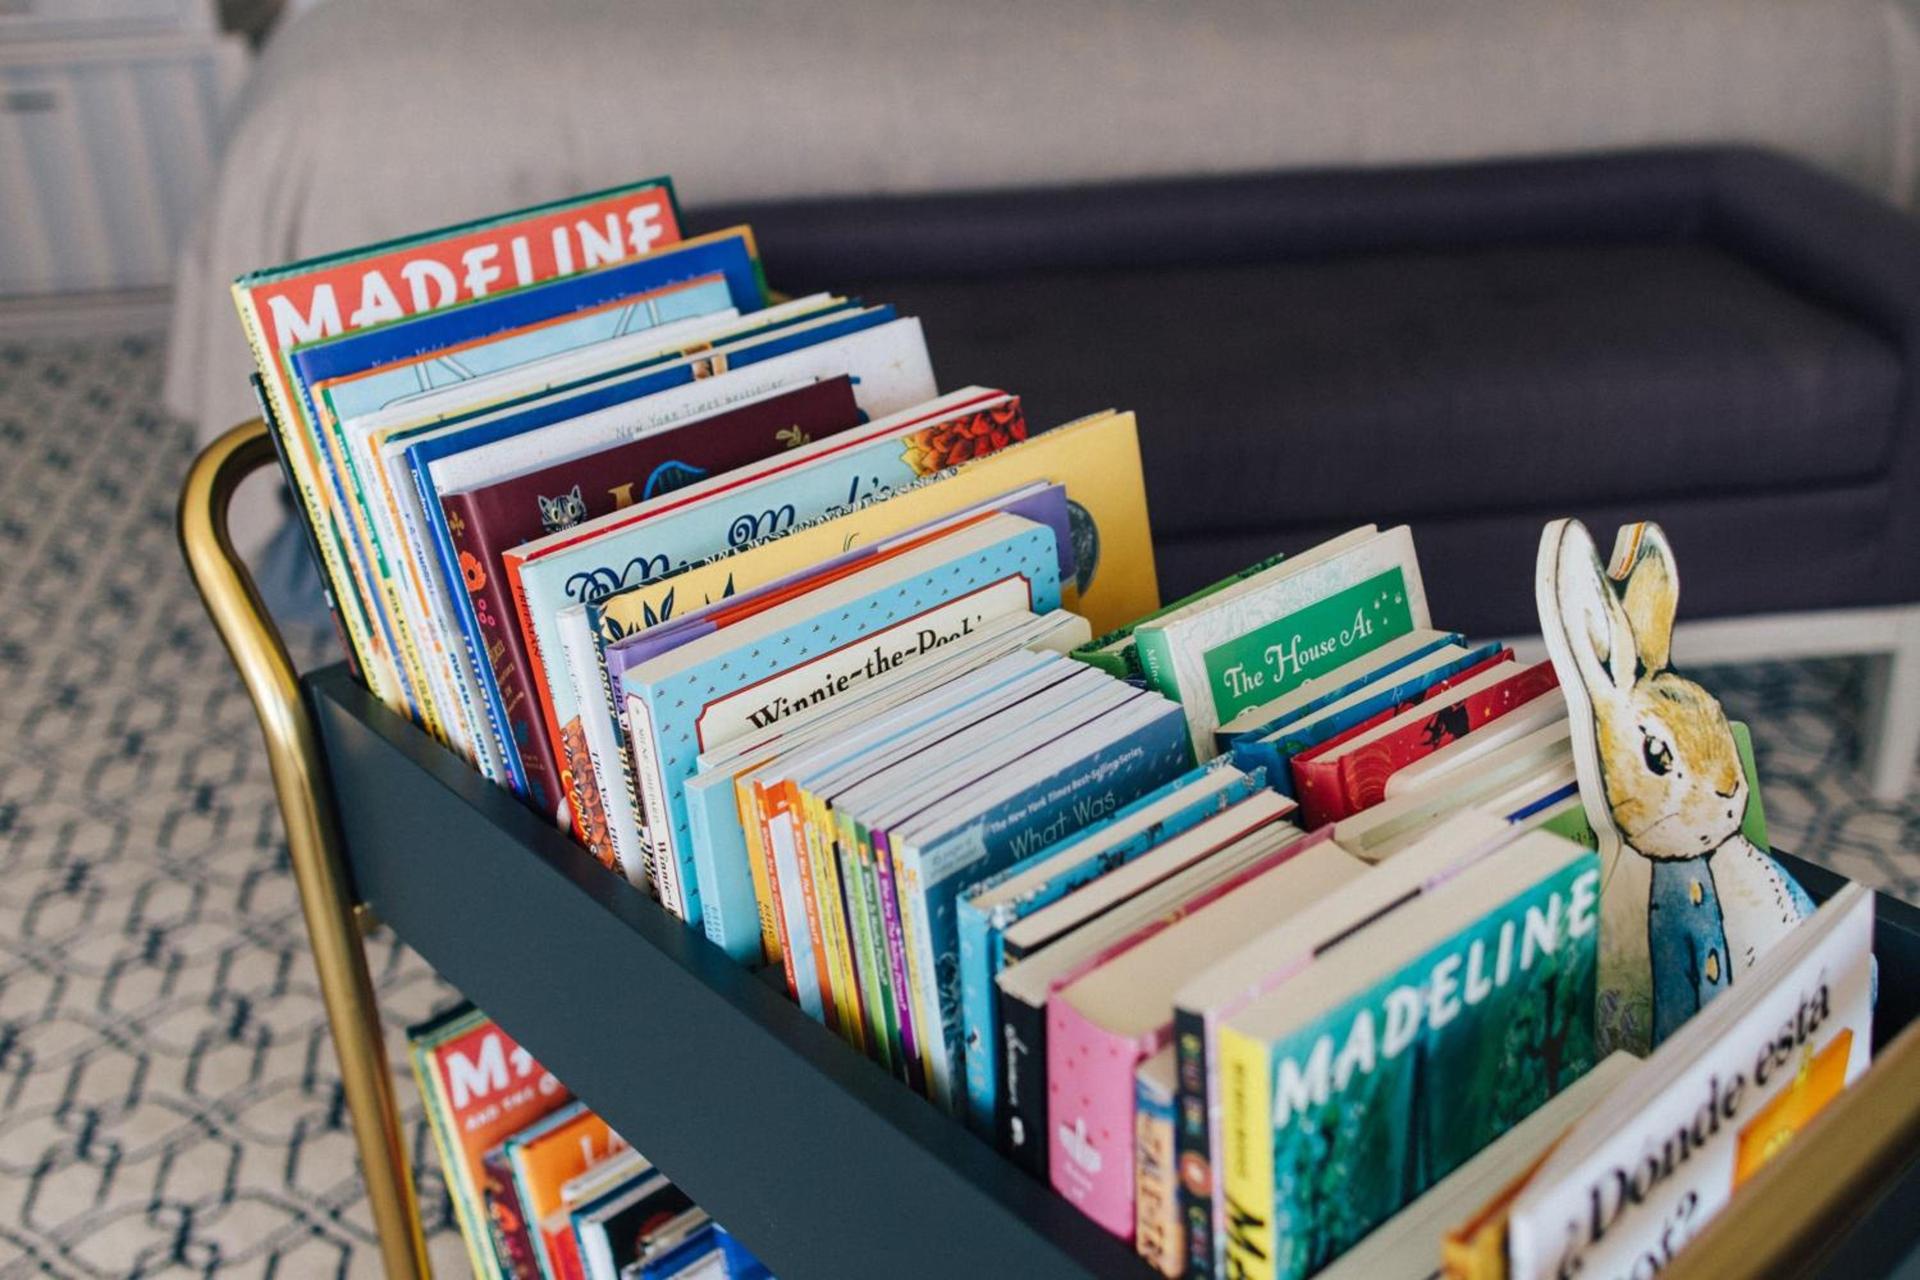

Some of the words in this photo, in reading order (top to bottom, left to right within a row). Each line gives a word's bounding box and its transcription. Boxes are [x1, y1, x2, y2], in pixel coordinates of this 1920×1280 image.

[1224, 663, 1265, 698] The
[1265, 634, 1337, 684] House
[1340, 607, 1374, 648] At
[1008, 809, 1027, 823] New
[1028, 796, 1047, 813] York
[1048, 786, 1072, 801] Times
[1008, 809, 1068, 860] What
[1072, 789, 1118, 826] Was
[1273, 868, 1601, 1130] MADELINE
